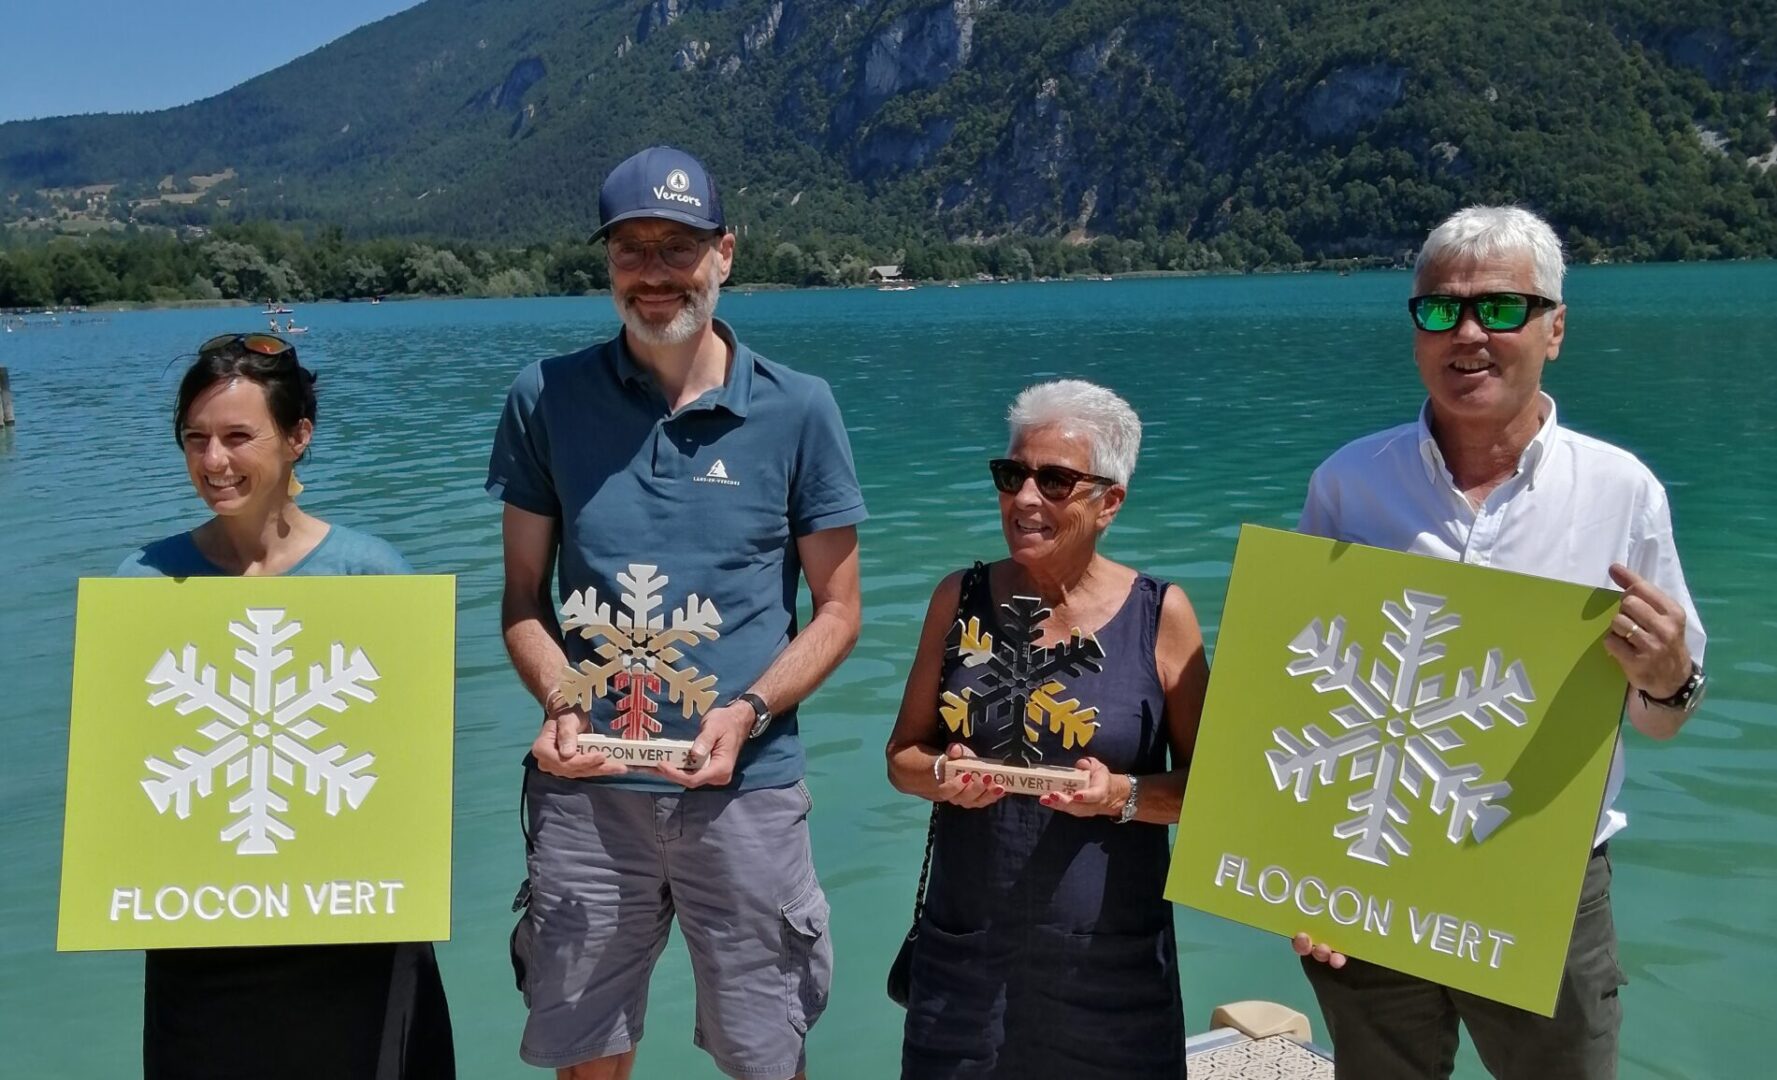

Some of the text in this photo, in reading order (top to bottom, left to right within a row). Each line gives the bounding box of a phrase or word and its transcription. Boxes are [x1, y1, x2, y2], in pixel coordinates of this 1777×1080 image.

[653, 185, 701, 207] Vercors
[639, 748, 673, 761] VERT
[1019, 776, 1053, 791] VERT
[110, 880, 404, 921] FLOCON VERT
[1214, 853, 1515, 969] FLOCON VERT
